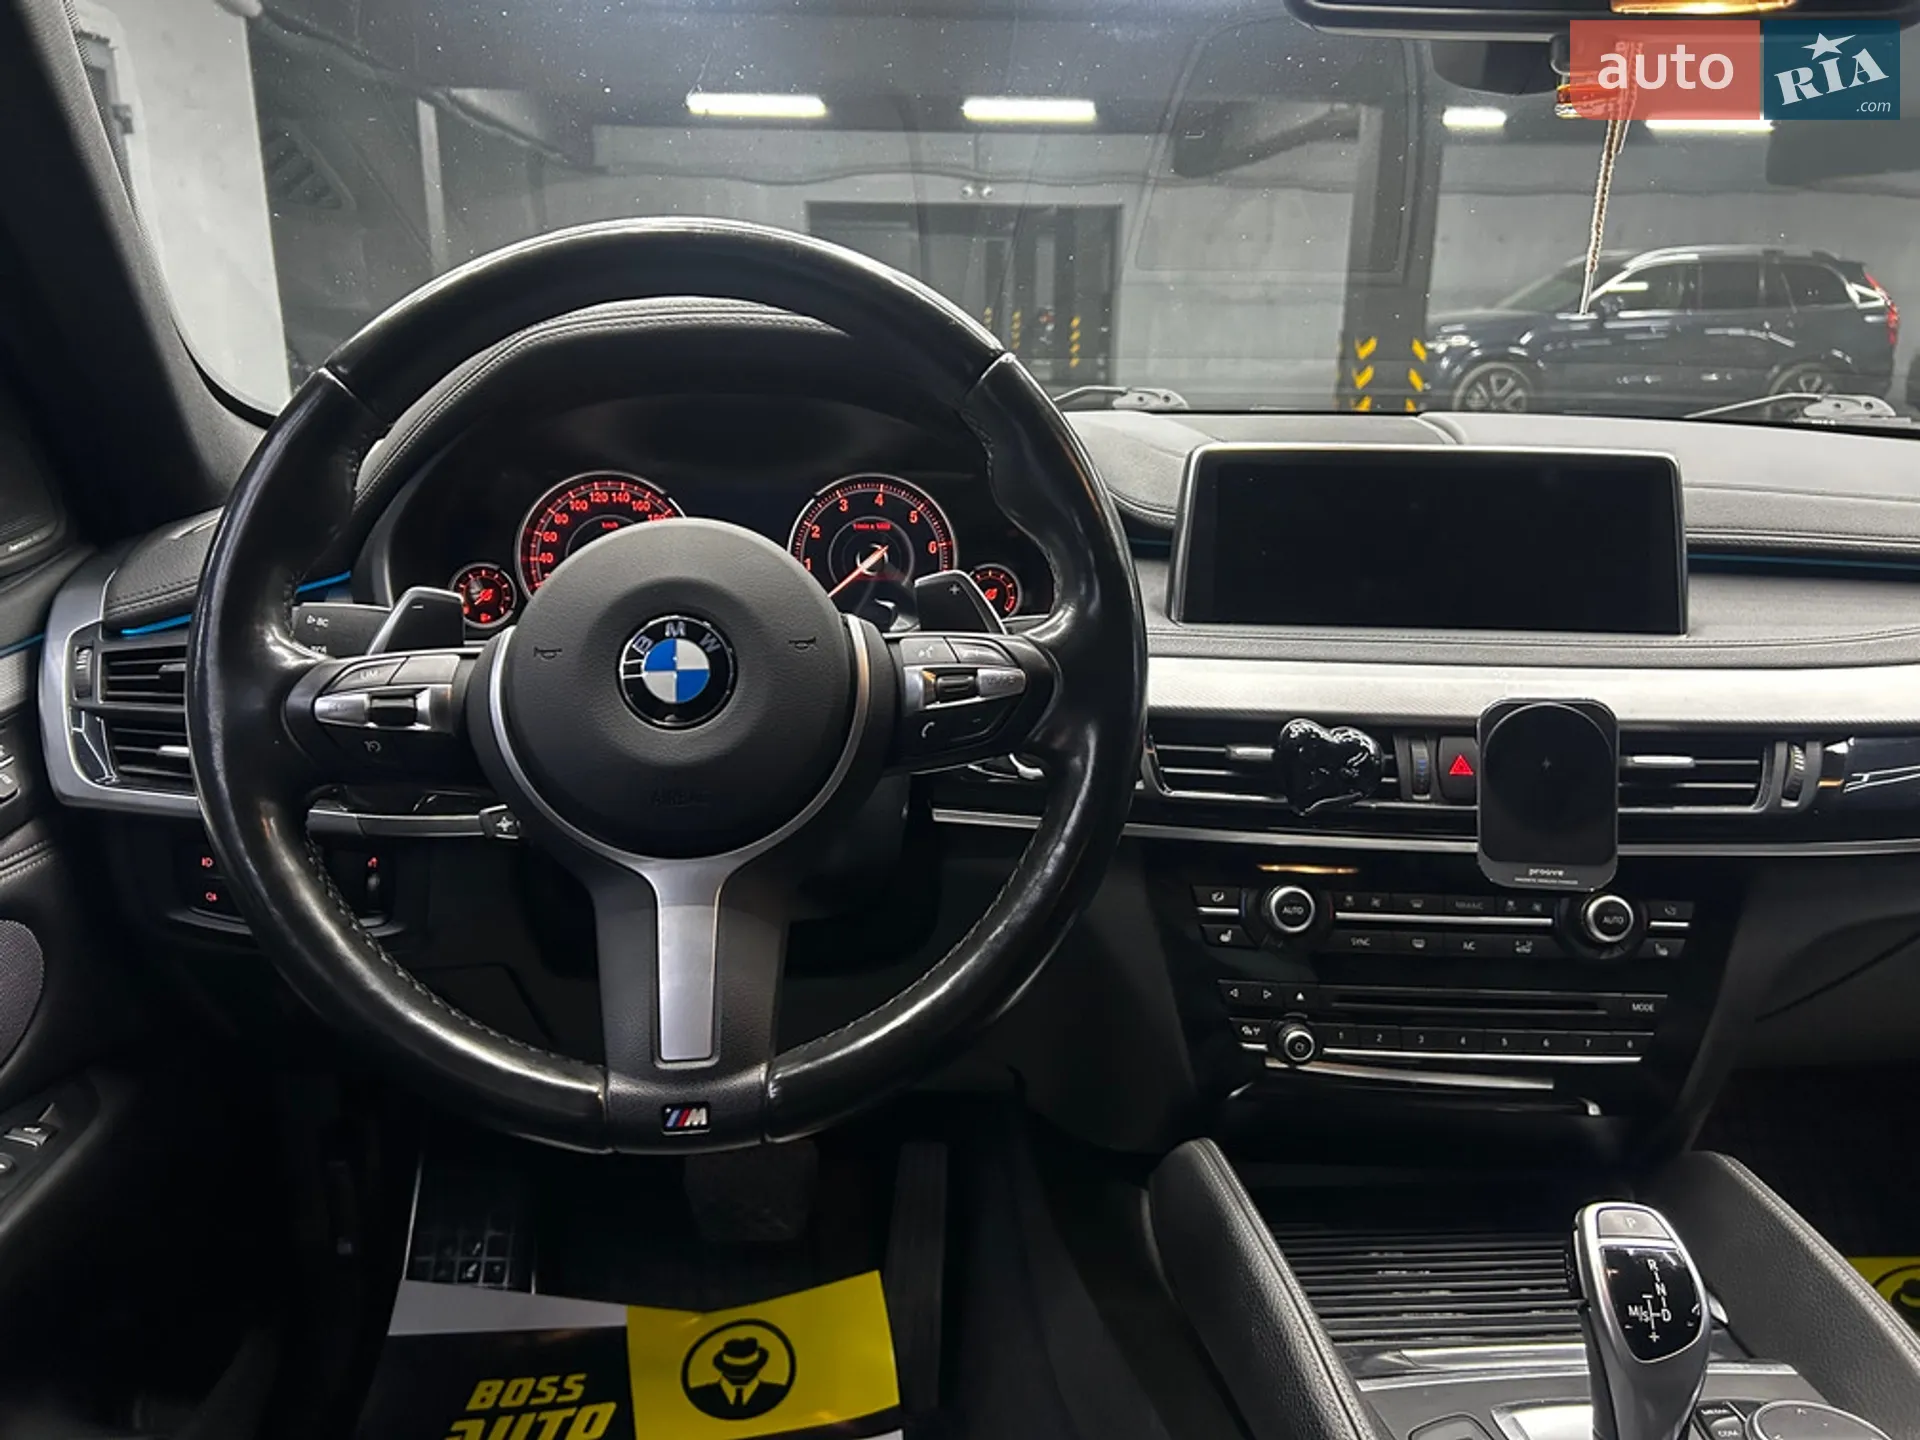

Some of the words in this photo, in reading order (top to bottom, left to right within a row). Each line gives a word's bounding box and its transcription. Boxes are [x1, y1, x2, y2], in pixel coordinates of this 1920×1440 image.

[569, 495, 588, 511] 100
[589, 491, 609, 504] 120
[611, 491, 631, 504] 140
[874, 493, 884, 508] 4
[838, 499, 849, 513] 3
[908, 510, 919, 524] 5
[811, 525, 821, 539] 2
[928, 541, 937, 555] 6
[631, 620, 722, 656] BMW
[1282, 905, 1304, 916] AUTO
[1602, 915, 1625, 926] AUTO
[1632, 1002, 1655, 1013] MODE
[1625, 1216, 1637, 1229] P
[1647, 1258, 1659, 1272] R
[1654, 1282, 1668, 1297] N
[1661, 1307, 1672, 1323] D
[465, 1373, 587, 1411] BOSS
[443, 1401, 617, 1440] AUTO
